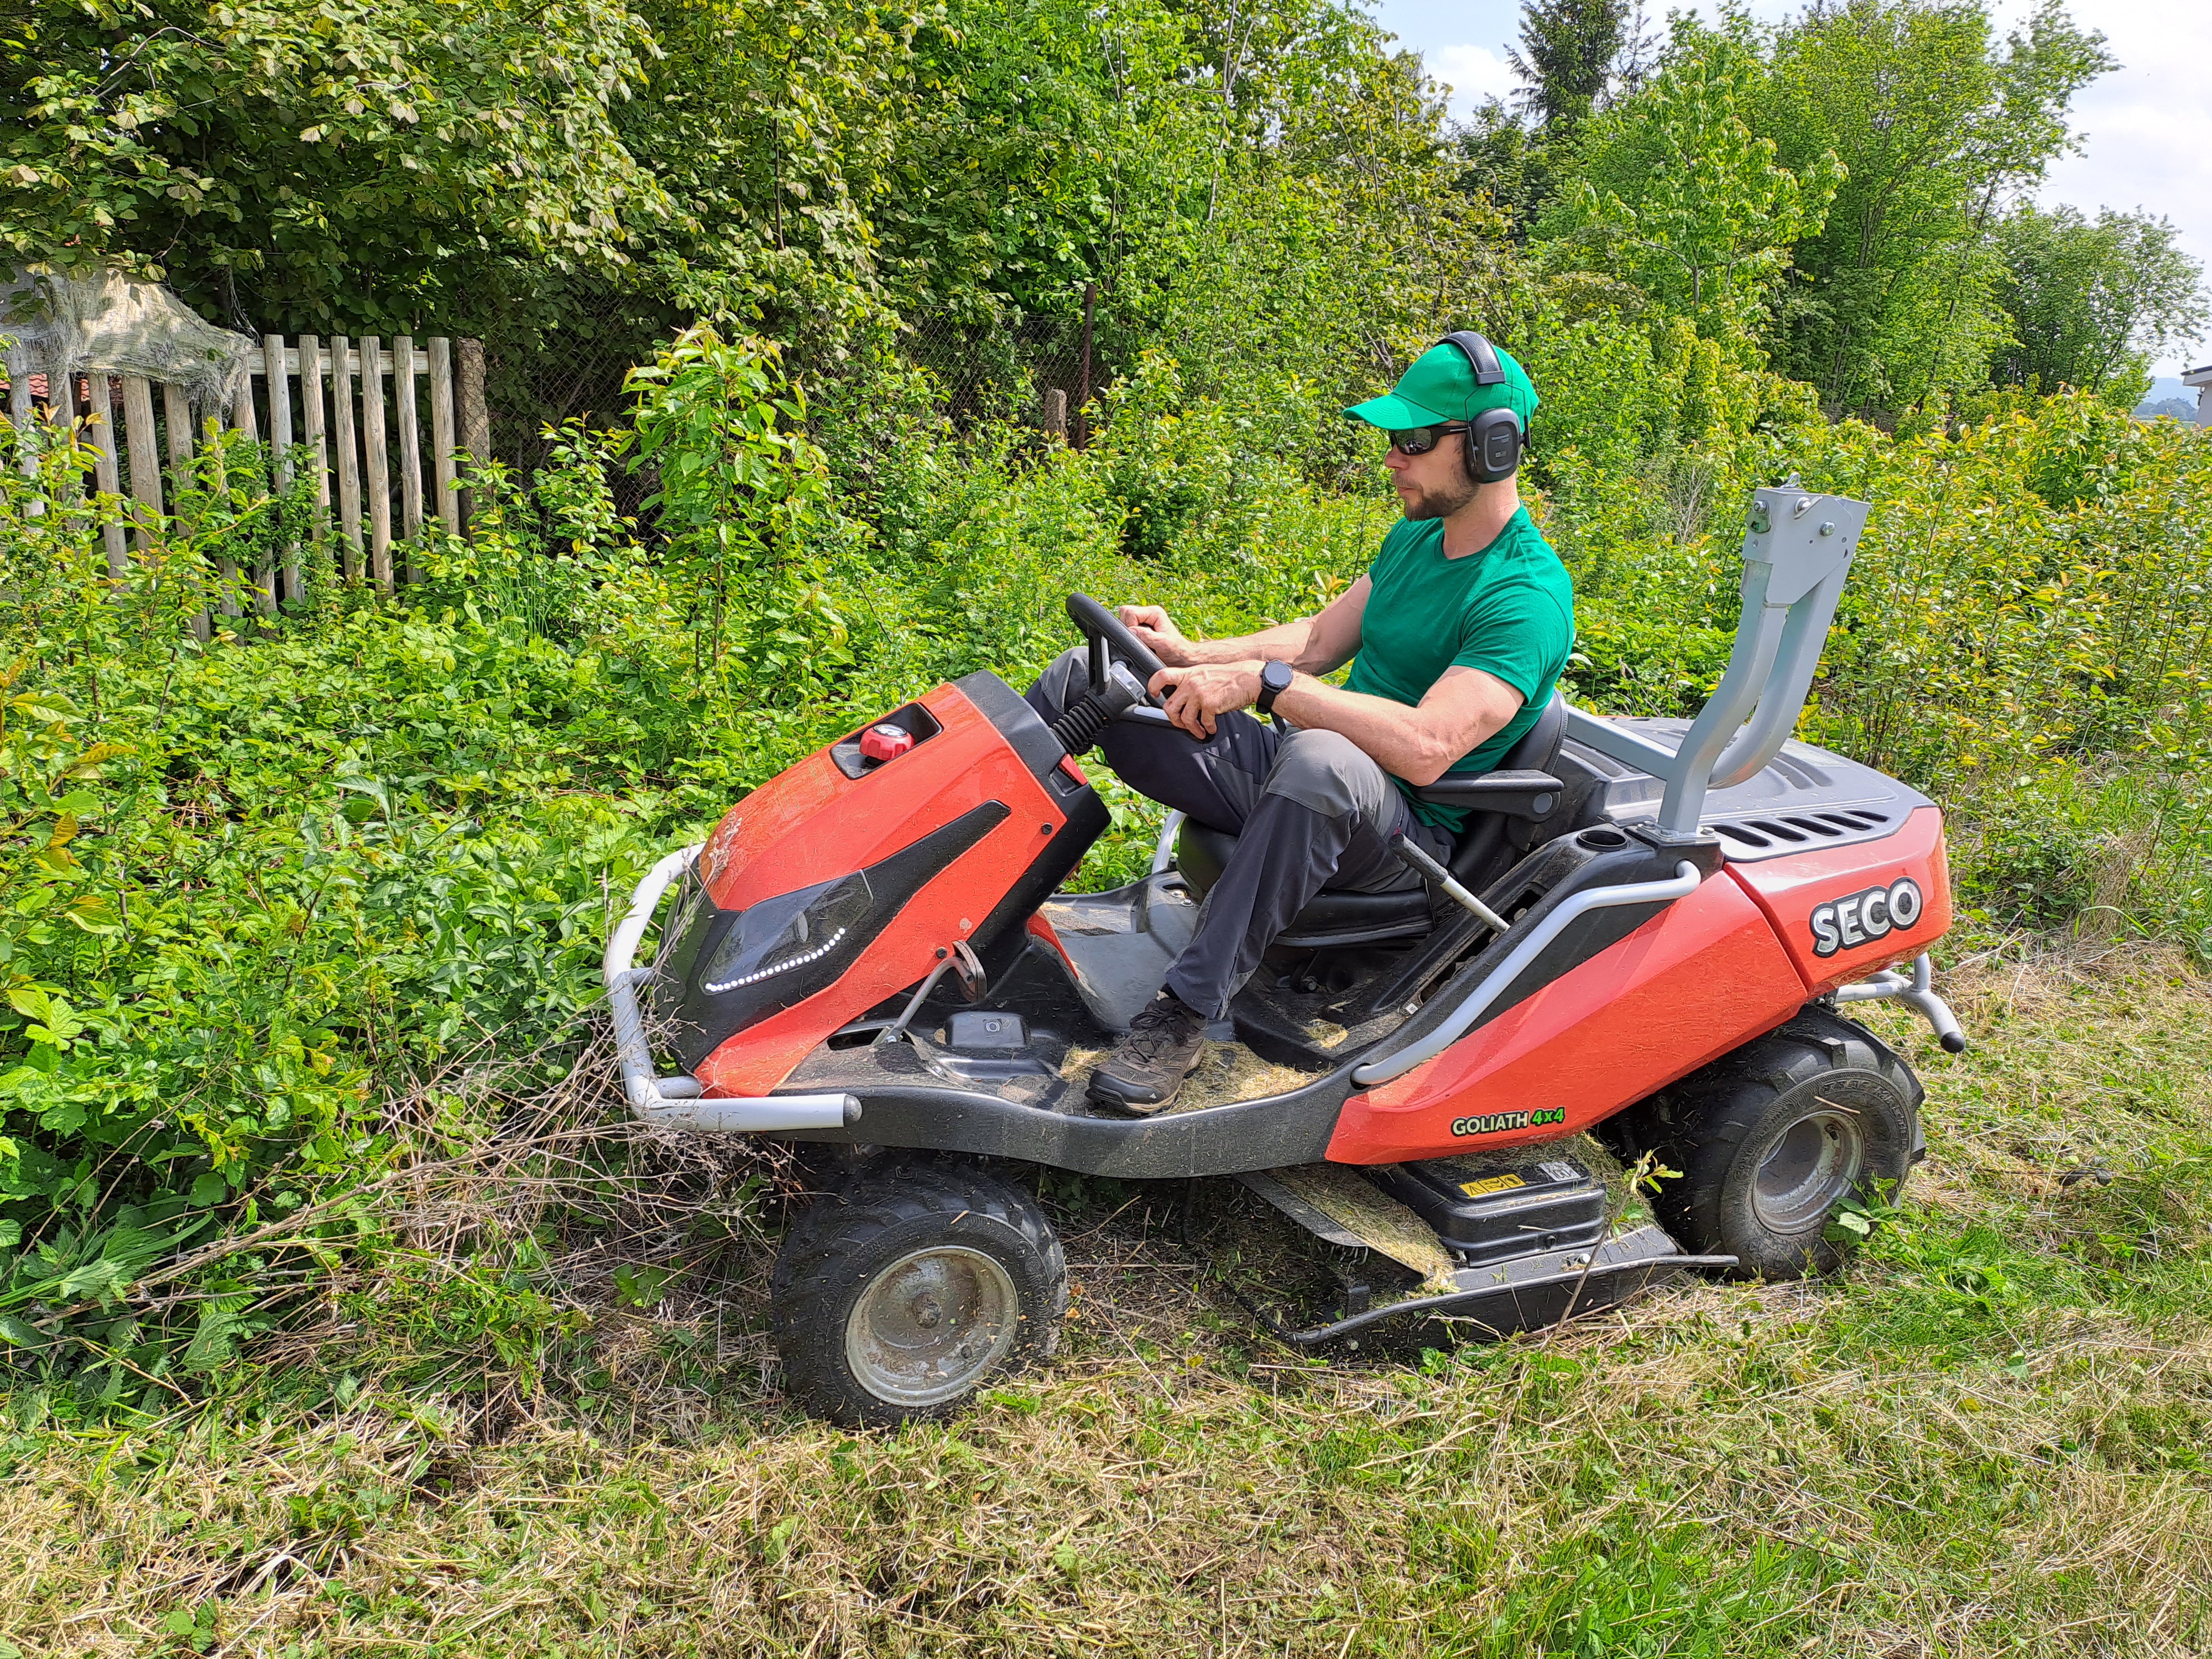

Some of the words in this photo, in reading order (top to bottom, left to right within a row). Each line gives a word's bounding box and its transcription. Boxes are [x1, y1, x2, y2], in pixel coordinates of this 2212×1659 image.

[1811, 878, 1922, 956] SECO
[1452, 1112, 1529, 1135] GOLIATH
[1531, 1108, 1564, 1125] 4x4
